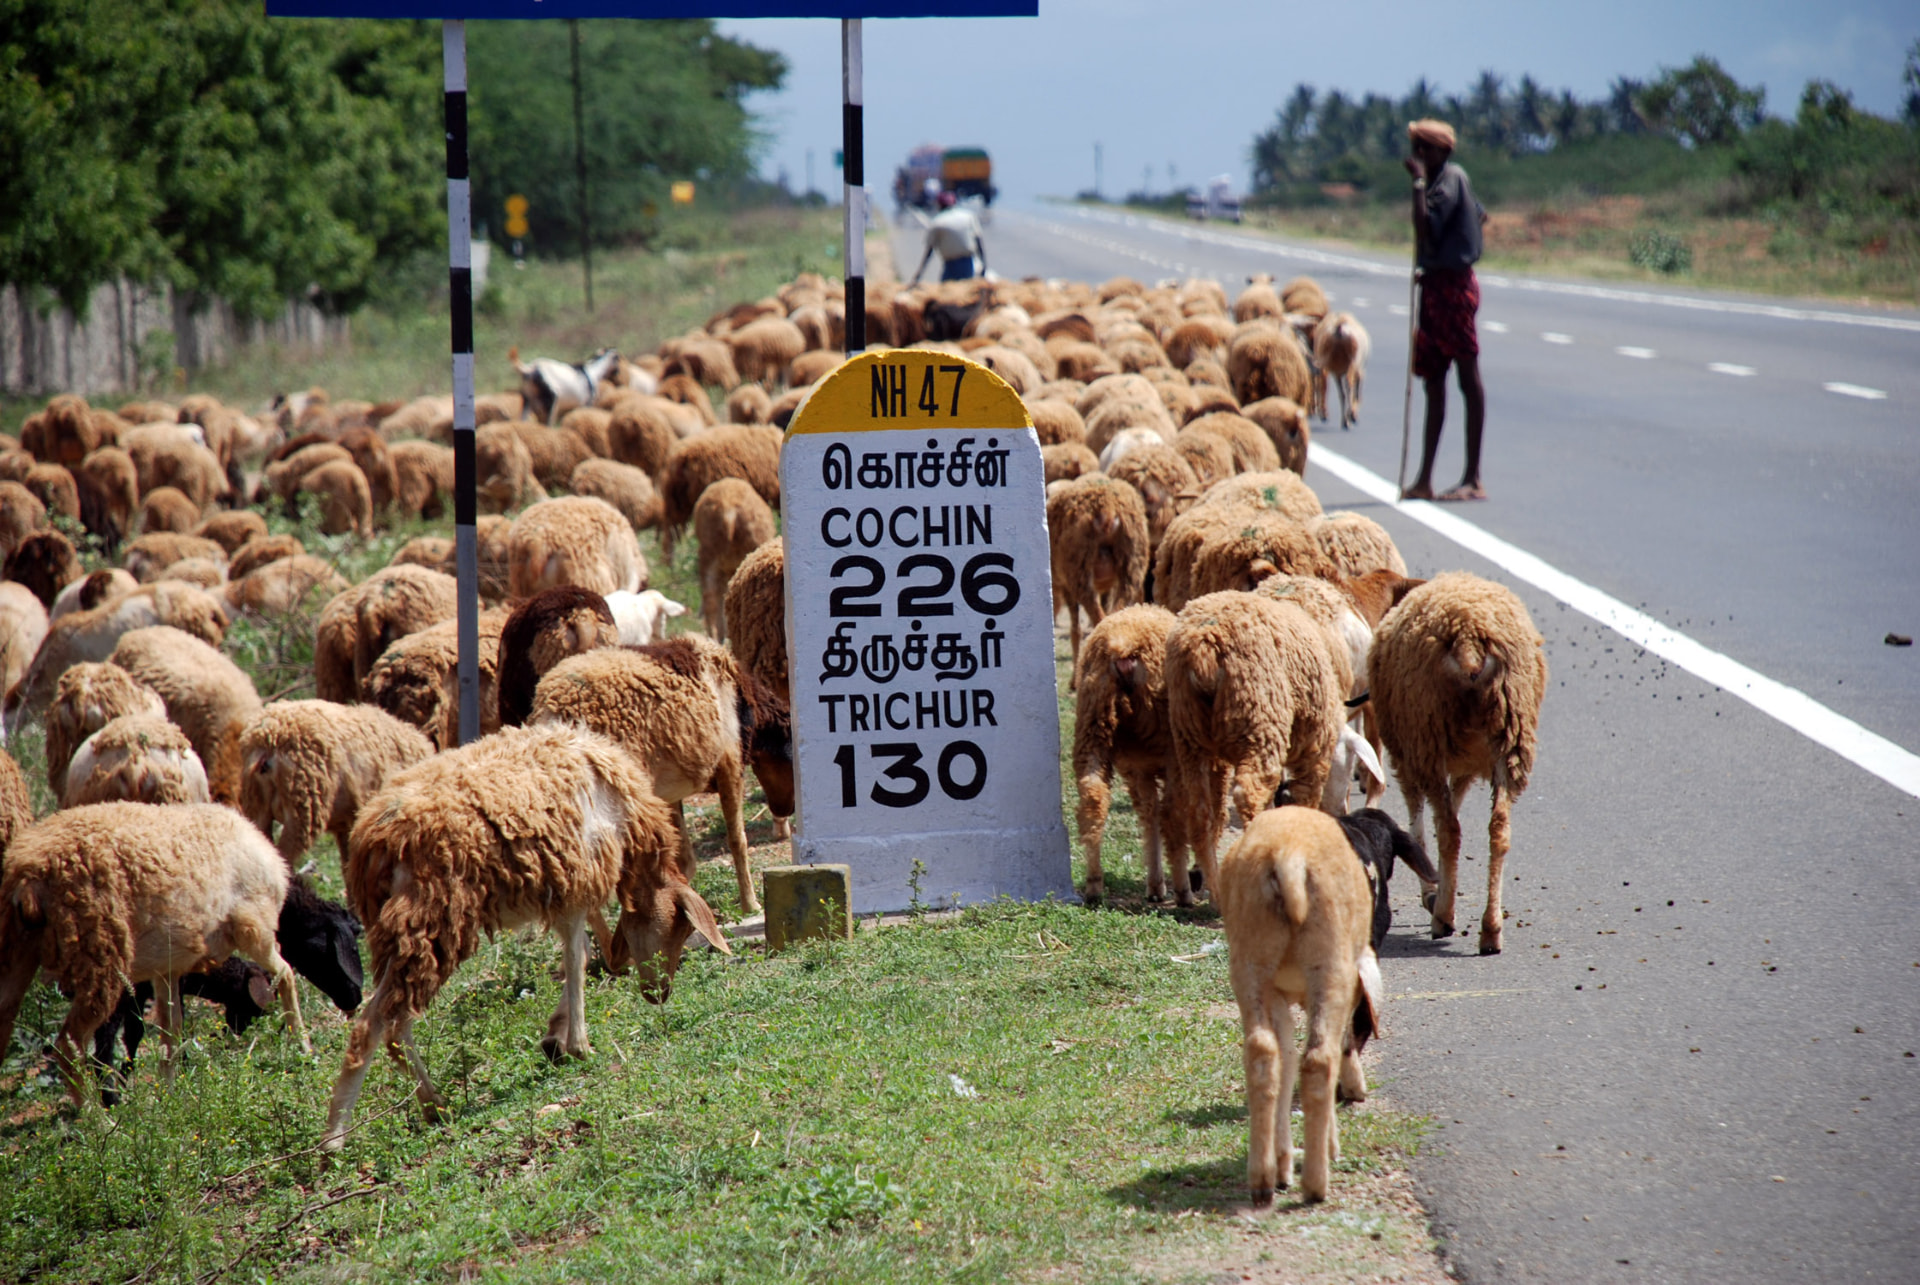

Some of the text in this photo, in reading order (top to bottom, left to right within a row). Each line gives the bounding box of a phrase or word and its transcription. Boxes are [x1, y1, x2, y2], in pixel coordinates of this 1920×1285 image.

[871, 364, 966, 418] NH 47
[822, 438, 1010, 489] கொச்சின்
[821, 505, 992, 548] COCHIN
[830, 553, 1020, 617] 226
[819, 618, 1005, 685] திருச்சூர்
[819, 689, 998, 733] TRICHUR
[834, 740, 987, 808] 130
